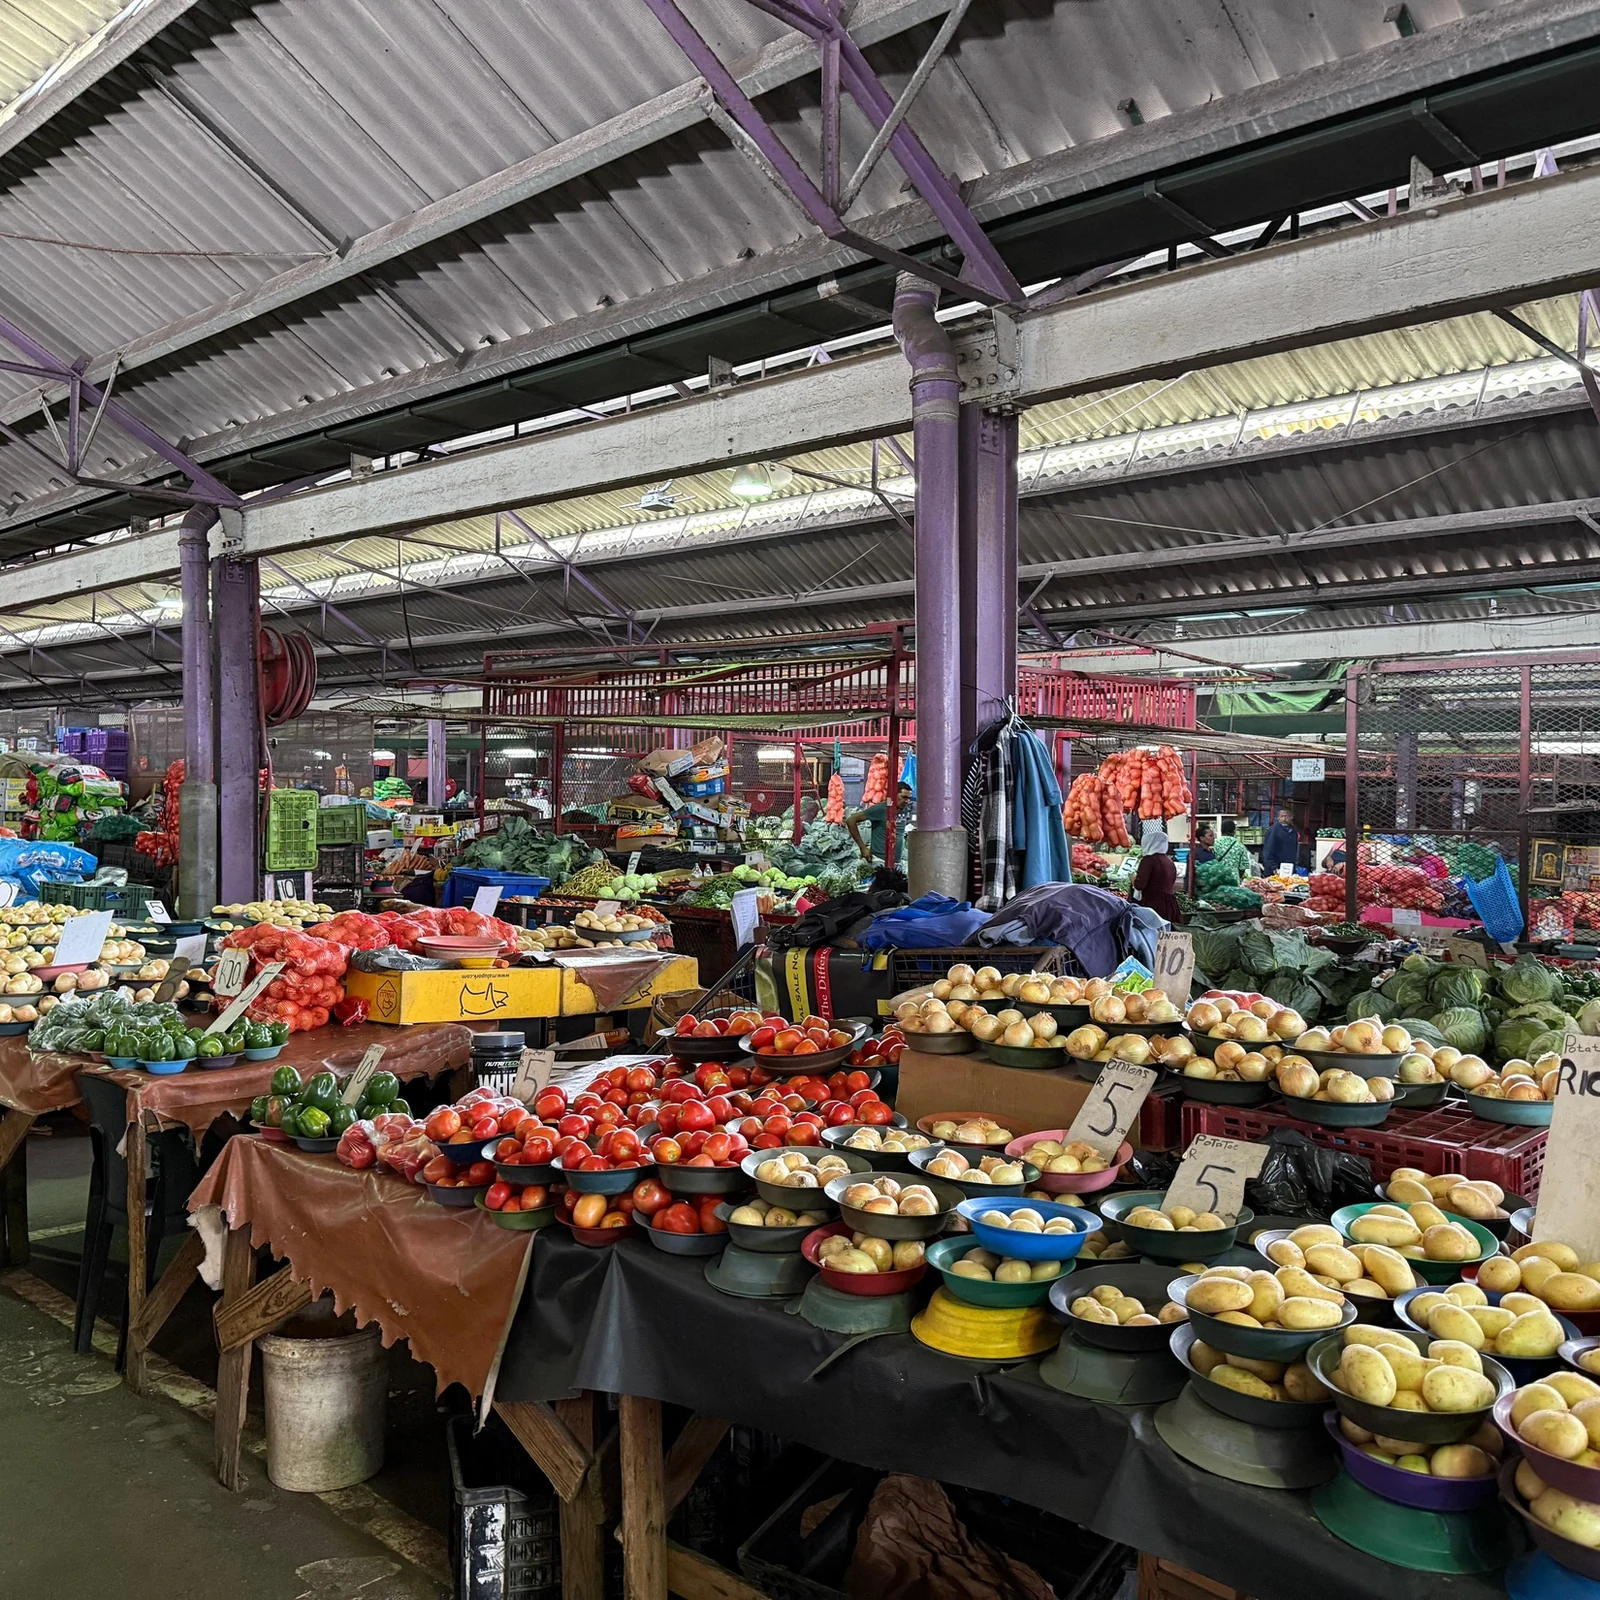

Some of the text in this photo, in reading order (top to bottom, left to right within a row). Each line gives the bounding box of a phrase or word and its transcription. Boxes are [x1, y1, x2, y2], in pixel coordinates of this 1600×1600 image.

[281, 879, 295, 899] 10
[150, 901, 165, 915] 5
[793, 973, 802, 1003] SALE
[820, 994, 831, 1017] The
[523, 1058, 547, 1104] 5
